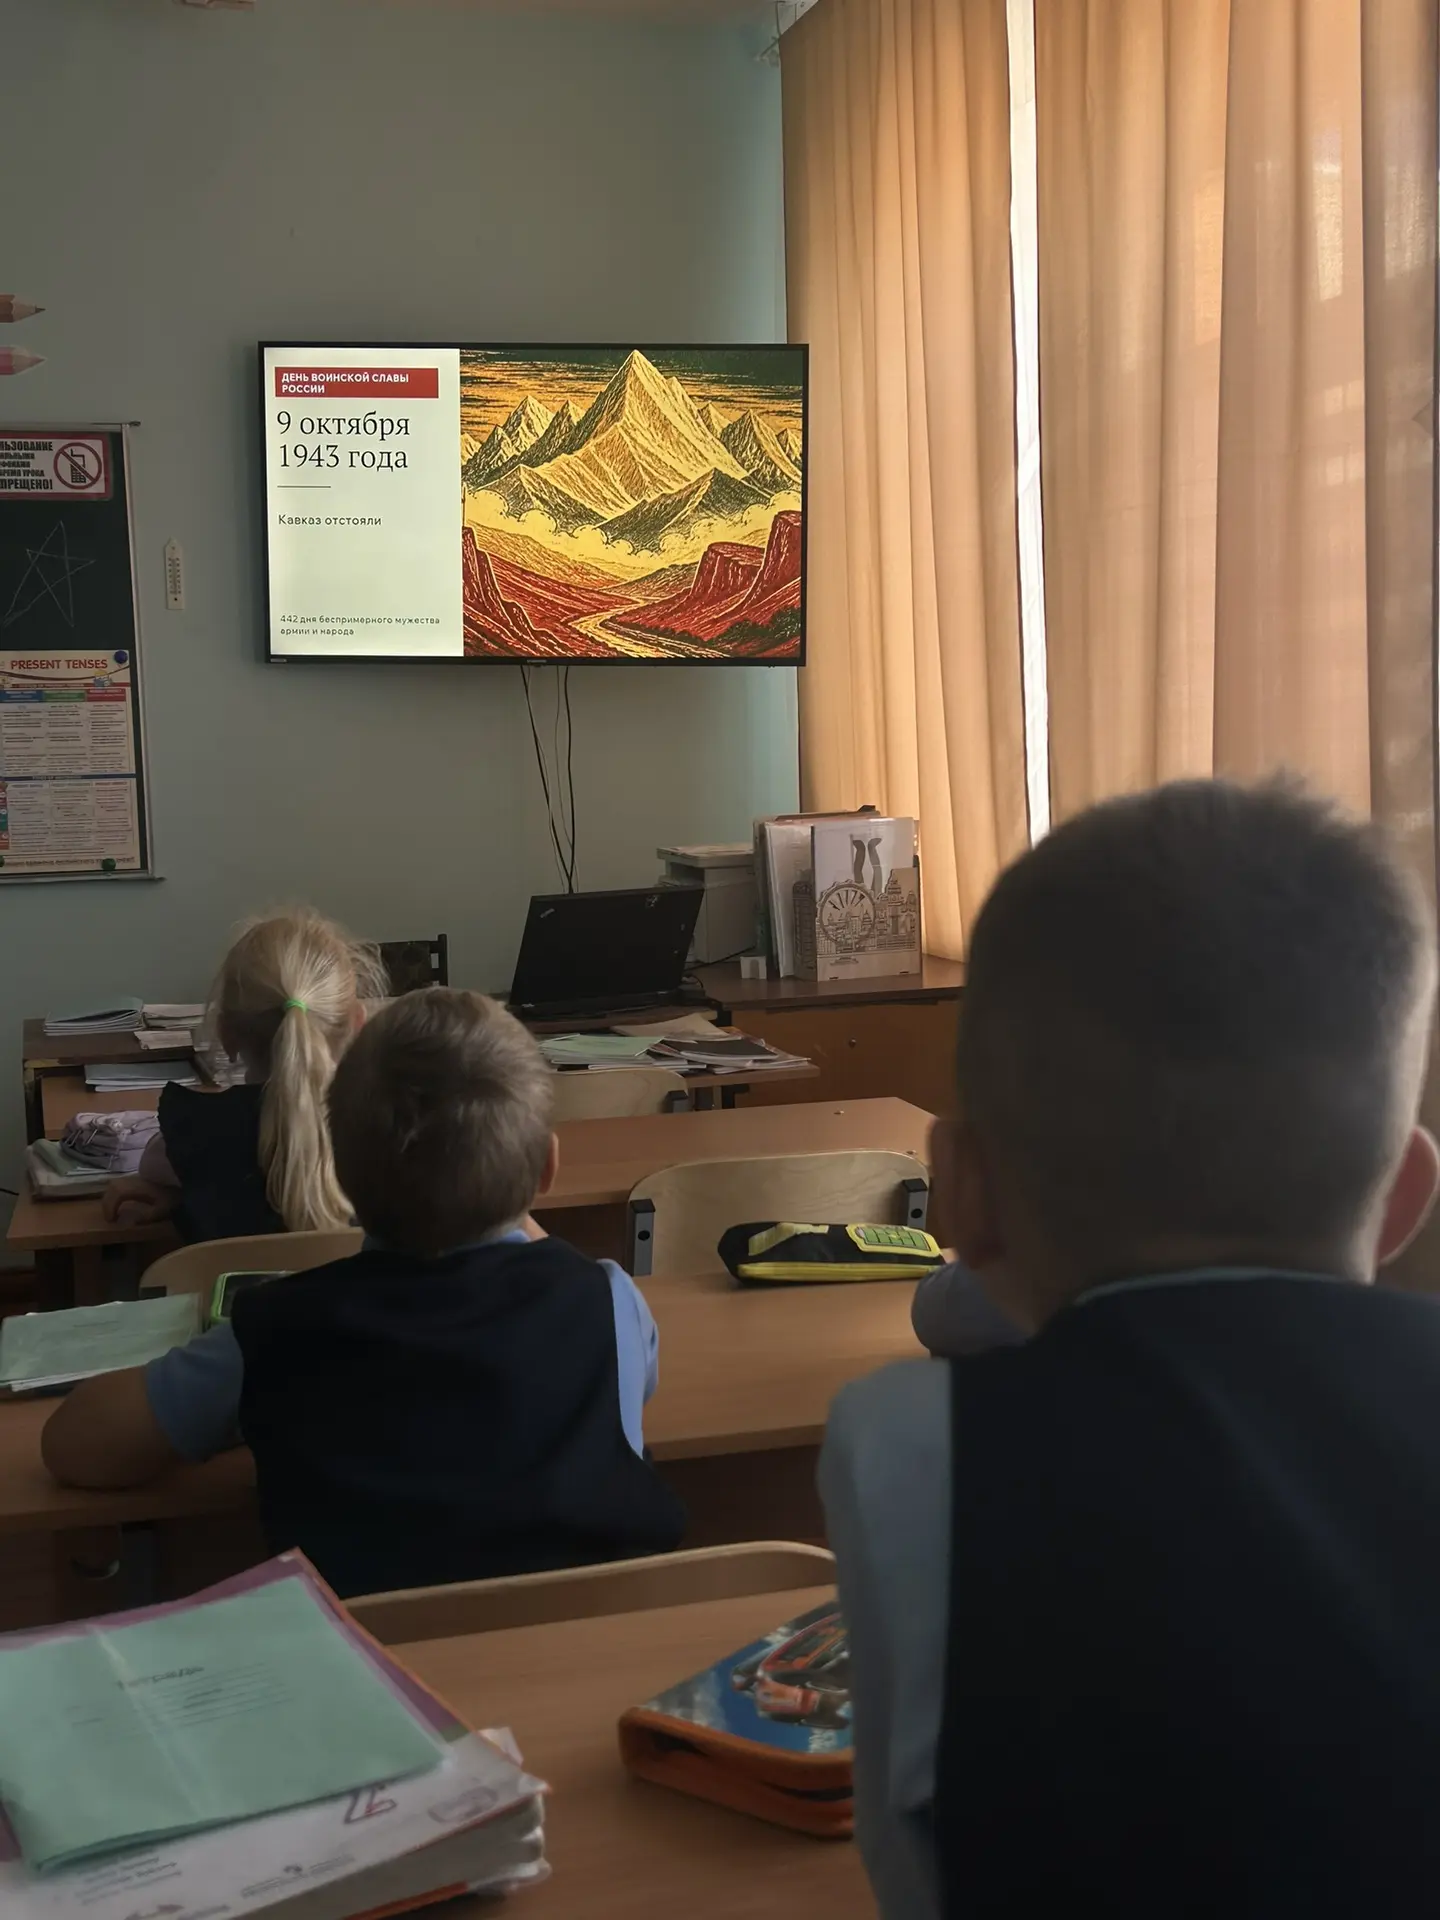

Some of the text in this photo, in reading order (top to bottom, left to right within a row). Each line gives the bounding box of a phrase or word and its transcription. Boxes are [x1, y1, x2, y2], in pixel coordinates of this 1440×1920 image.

[281, 372, 409, 384] ДЕНЬ ВОИНСКОЙ СЛАВЫ
[281, 384, 325, 393] РОССИИ
[277, 410, 410, 441] 9 октября
[279, 444, 409, 472] 1943 года
[278, 514, 382, 526] Кавказ отстояли
[280, 615, 440, 626] 442 дня беспримерного мужества
[280, 628, 310, 636] армии
[320, 628, 354, 636] народа
[10, 658, 108, 670] PRESENT TENSES
